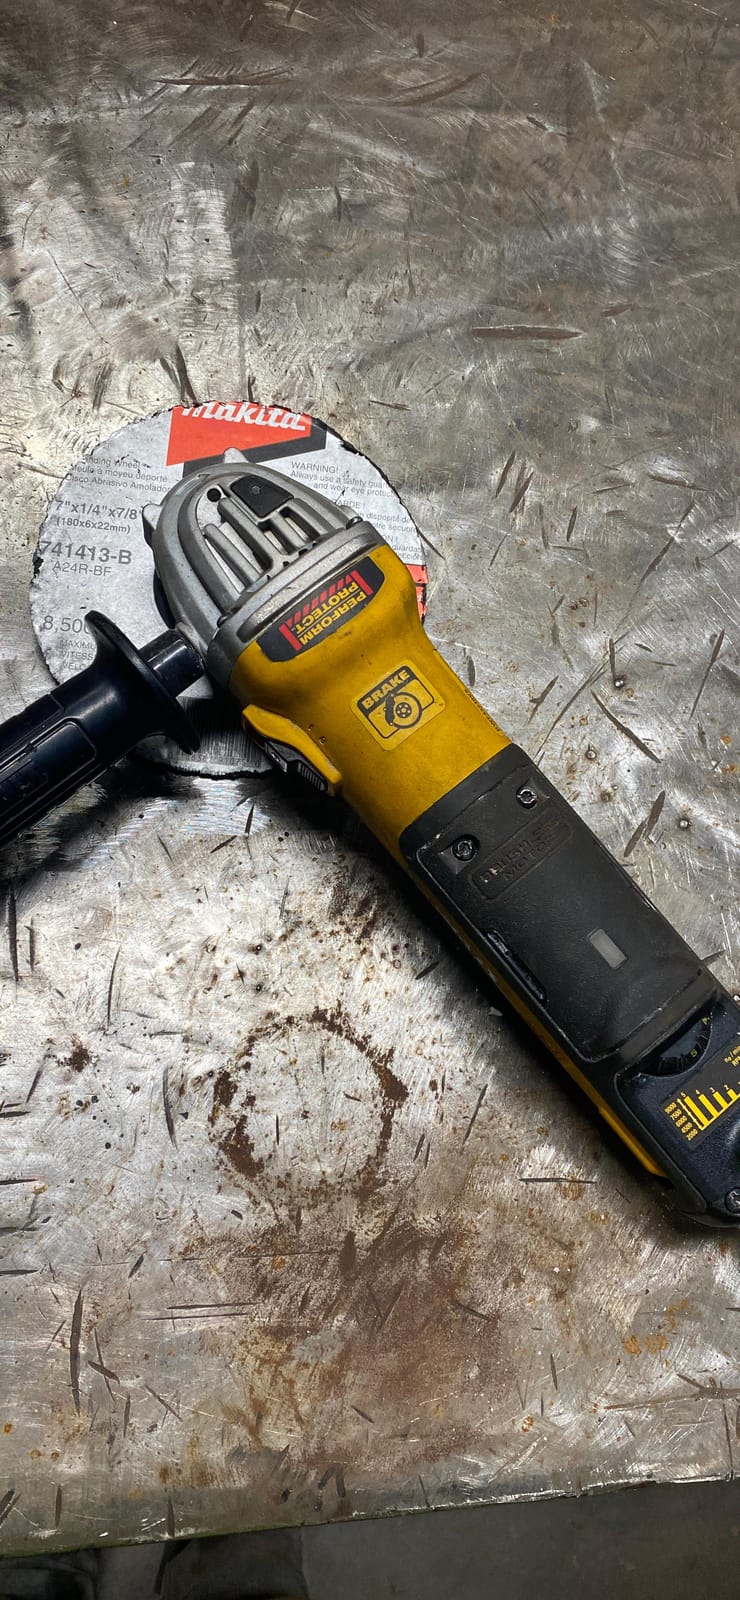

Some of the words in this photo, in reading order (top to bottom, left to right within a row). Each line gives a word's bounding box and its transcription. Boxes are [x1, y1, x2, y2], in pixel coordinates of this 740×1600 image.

[290, 470, 317, 480] Always
[291, 461, 338, 474] WARNING!
[93, 477, 128, 488] Abrasivo
[313, 480, 328, 490] and
[350, 486, 365, 495] eye
[56, 516, 131, 534] (180x6x22mm)
[40, 541, 133, 565] 741413-B
[52, 561, 113, 577] A24R-BF
[299, 590, 368, 646] PERFORM
[361, 669, 411, 710] BRAKE
